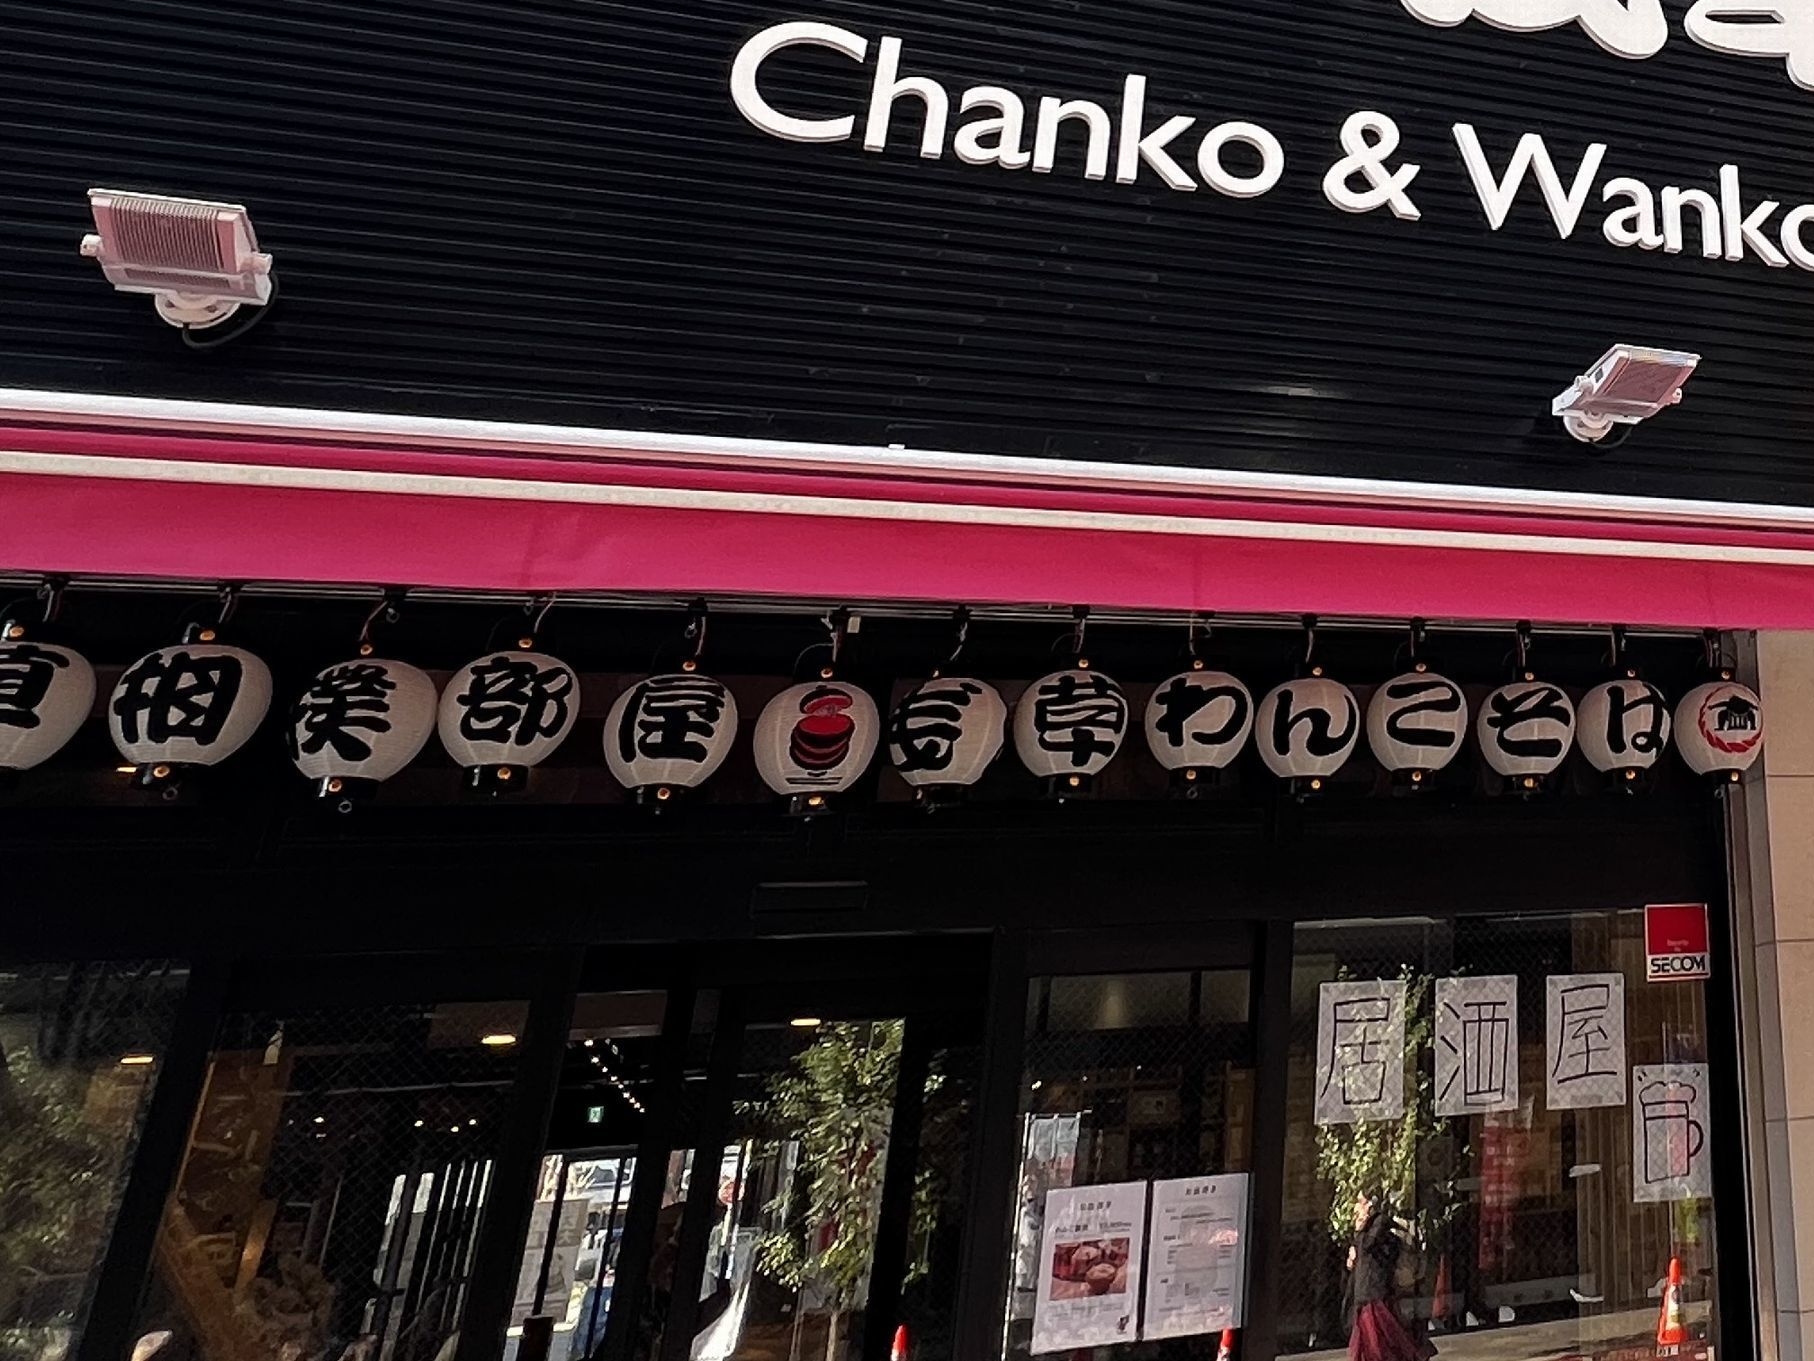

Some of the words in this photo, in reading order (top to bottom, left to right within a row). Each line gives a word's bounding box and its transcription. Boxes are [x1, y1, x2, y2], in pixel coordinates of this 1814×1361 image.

[729, 21, 1286, 198] Chanko
[1322, 110, 1422, 220] &
[1650, 954, 1706, 974] SECOM
[1321, 982, 1618, 1107] 居酒屋
